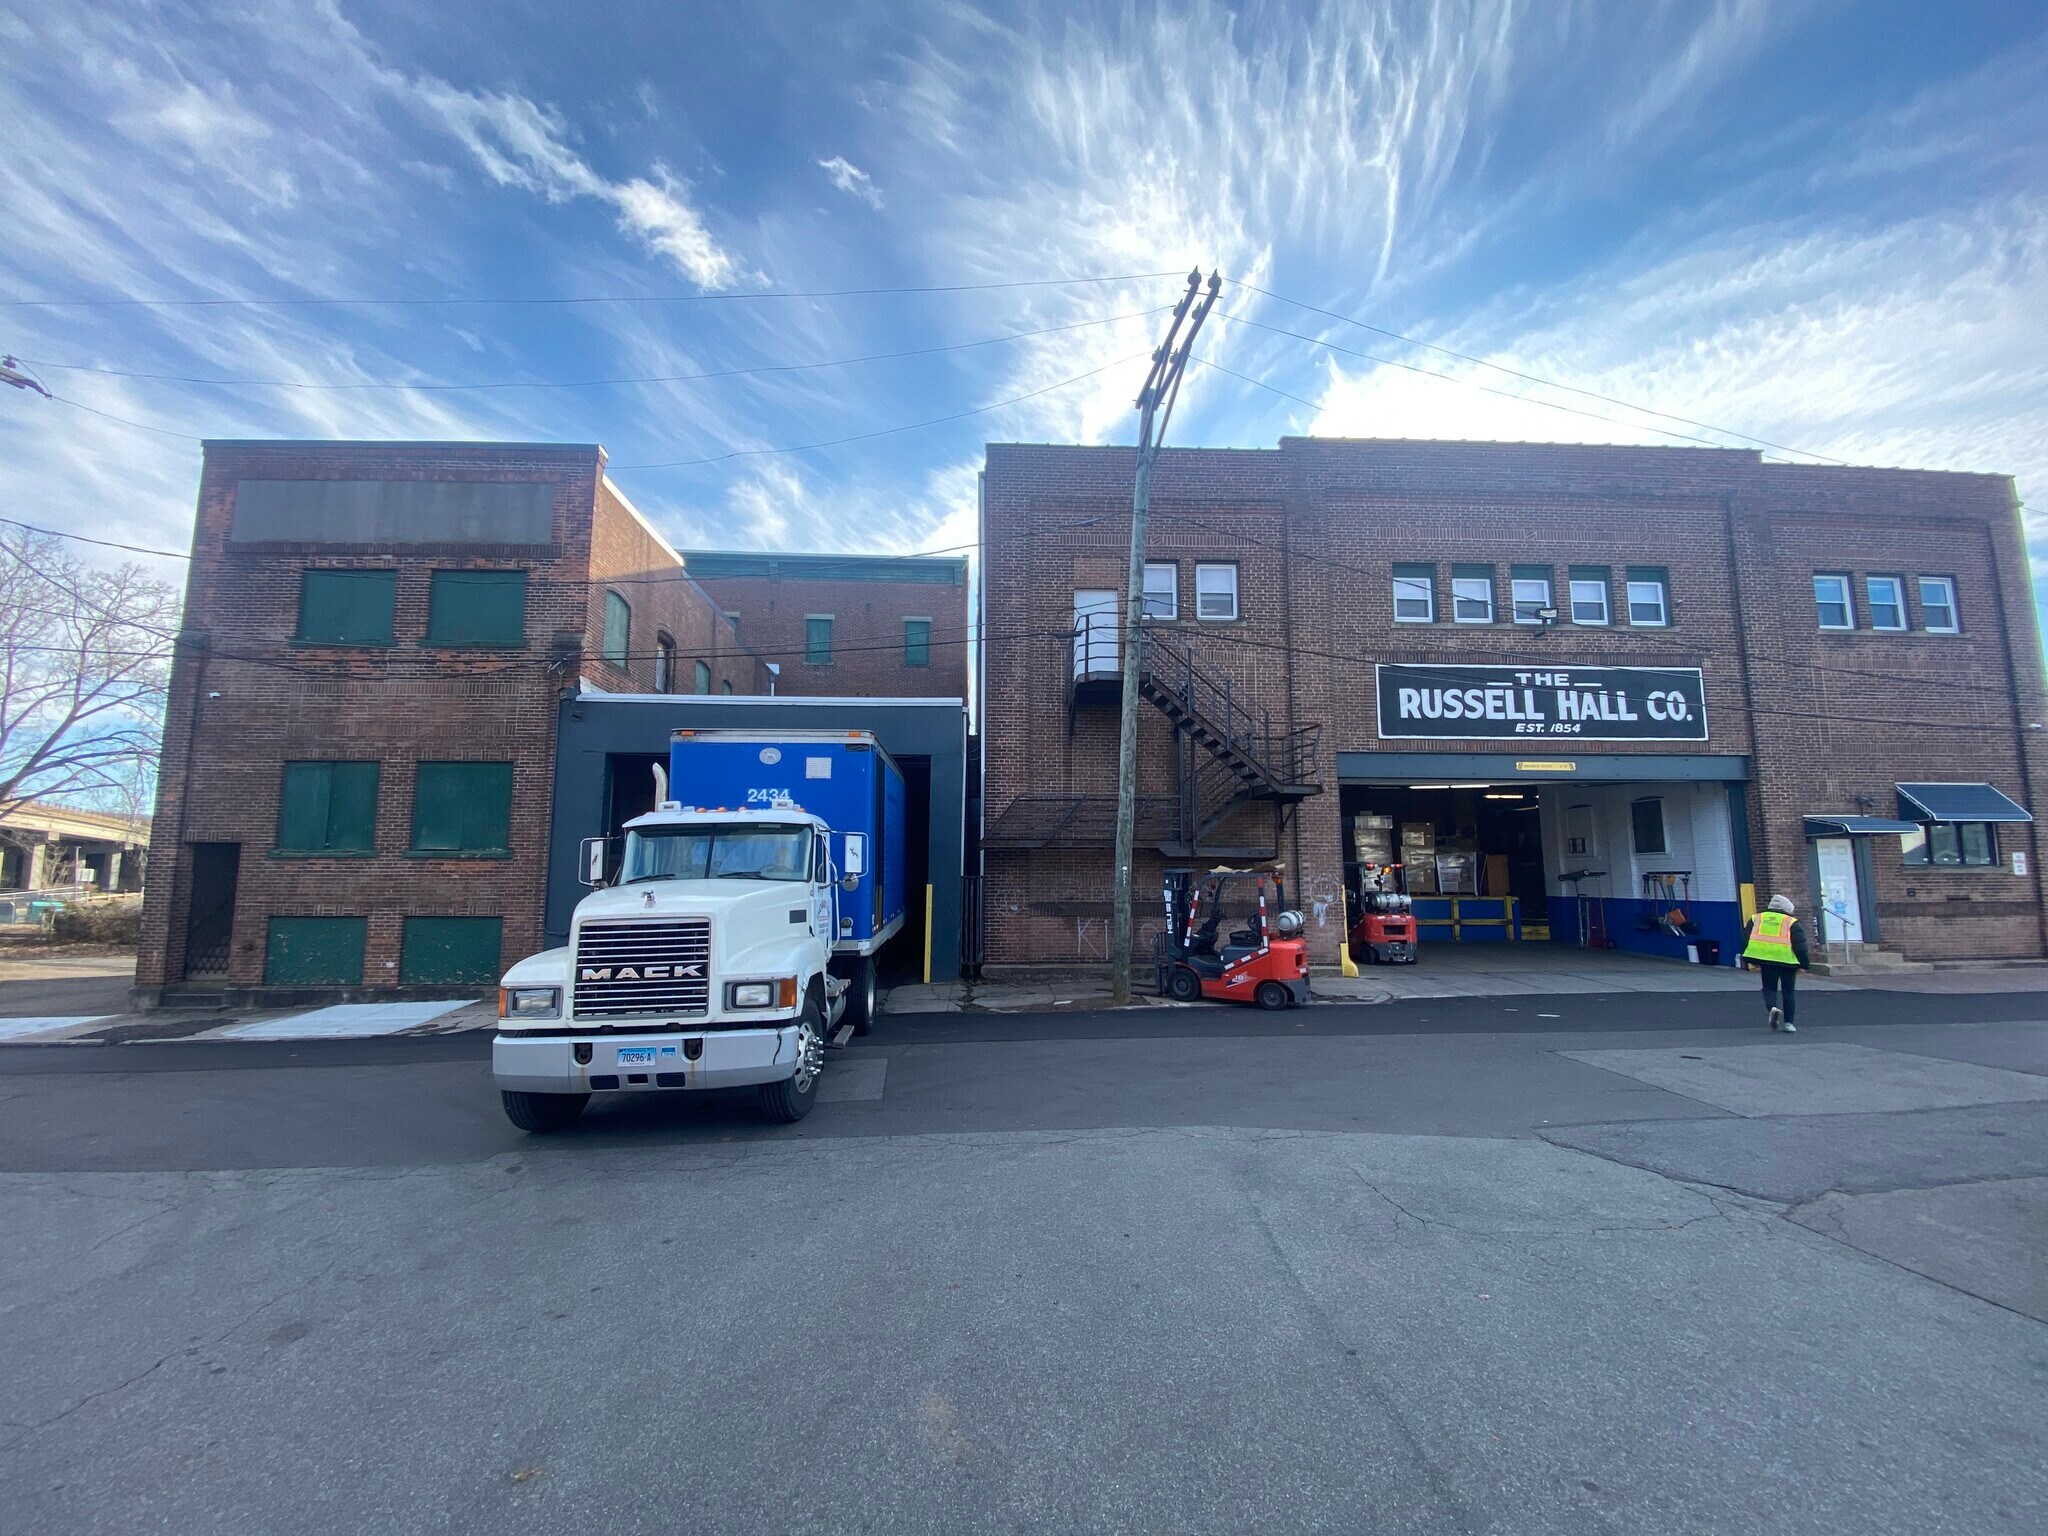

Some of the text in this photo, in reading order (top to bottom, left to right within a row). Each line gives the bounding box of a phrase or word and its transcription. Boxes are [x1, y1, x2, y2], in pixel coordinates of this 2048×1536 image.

[1515, 672, 1570, 687] THE
[1399, 688, 1693, 722] RUSSELL HALL CO.
[1515, 723, 1581, 733] EST. 1854
[747, 788, 790, 803] 2434
[581, 965, 703, 981] MACK
